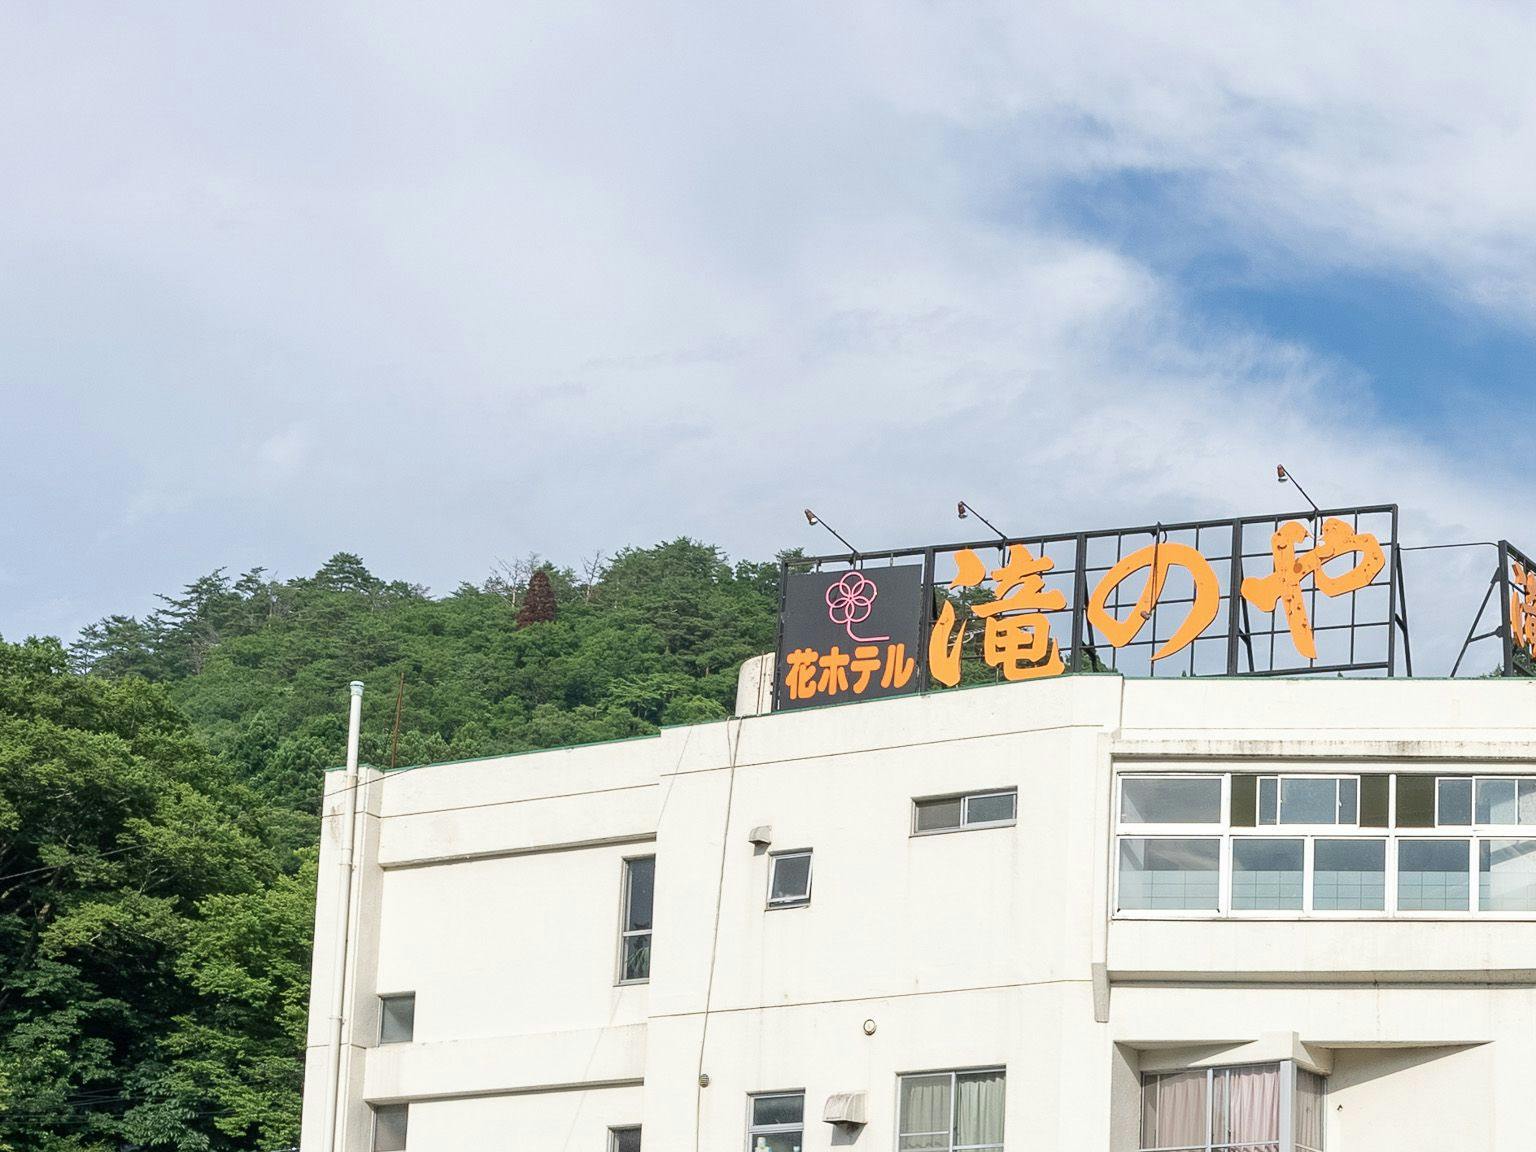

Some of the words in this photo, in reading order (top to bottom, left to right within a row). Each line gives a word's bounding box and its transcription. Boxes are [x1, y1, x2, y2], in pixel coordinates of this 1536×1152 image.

[786, 643, 915, 700] 花ホテル
[929, 518, 1386, 687] 滝のや
